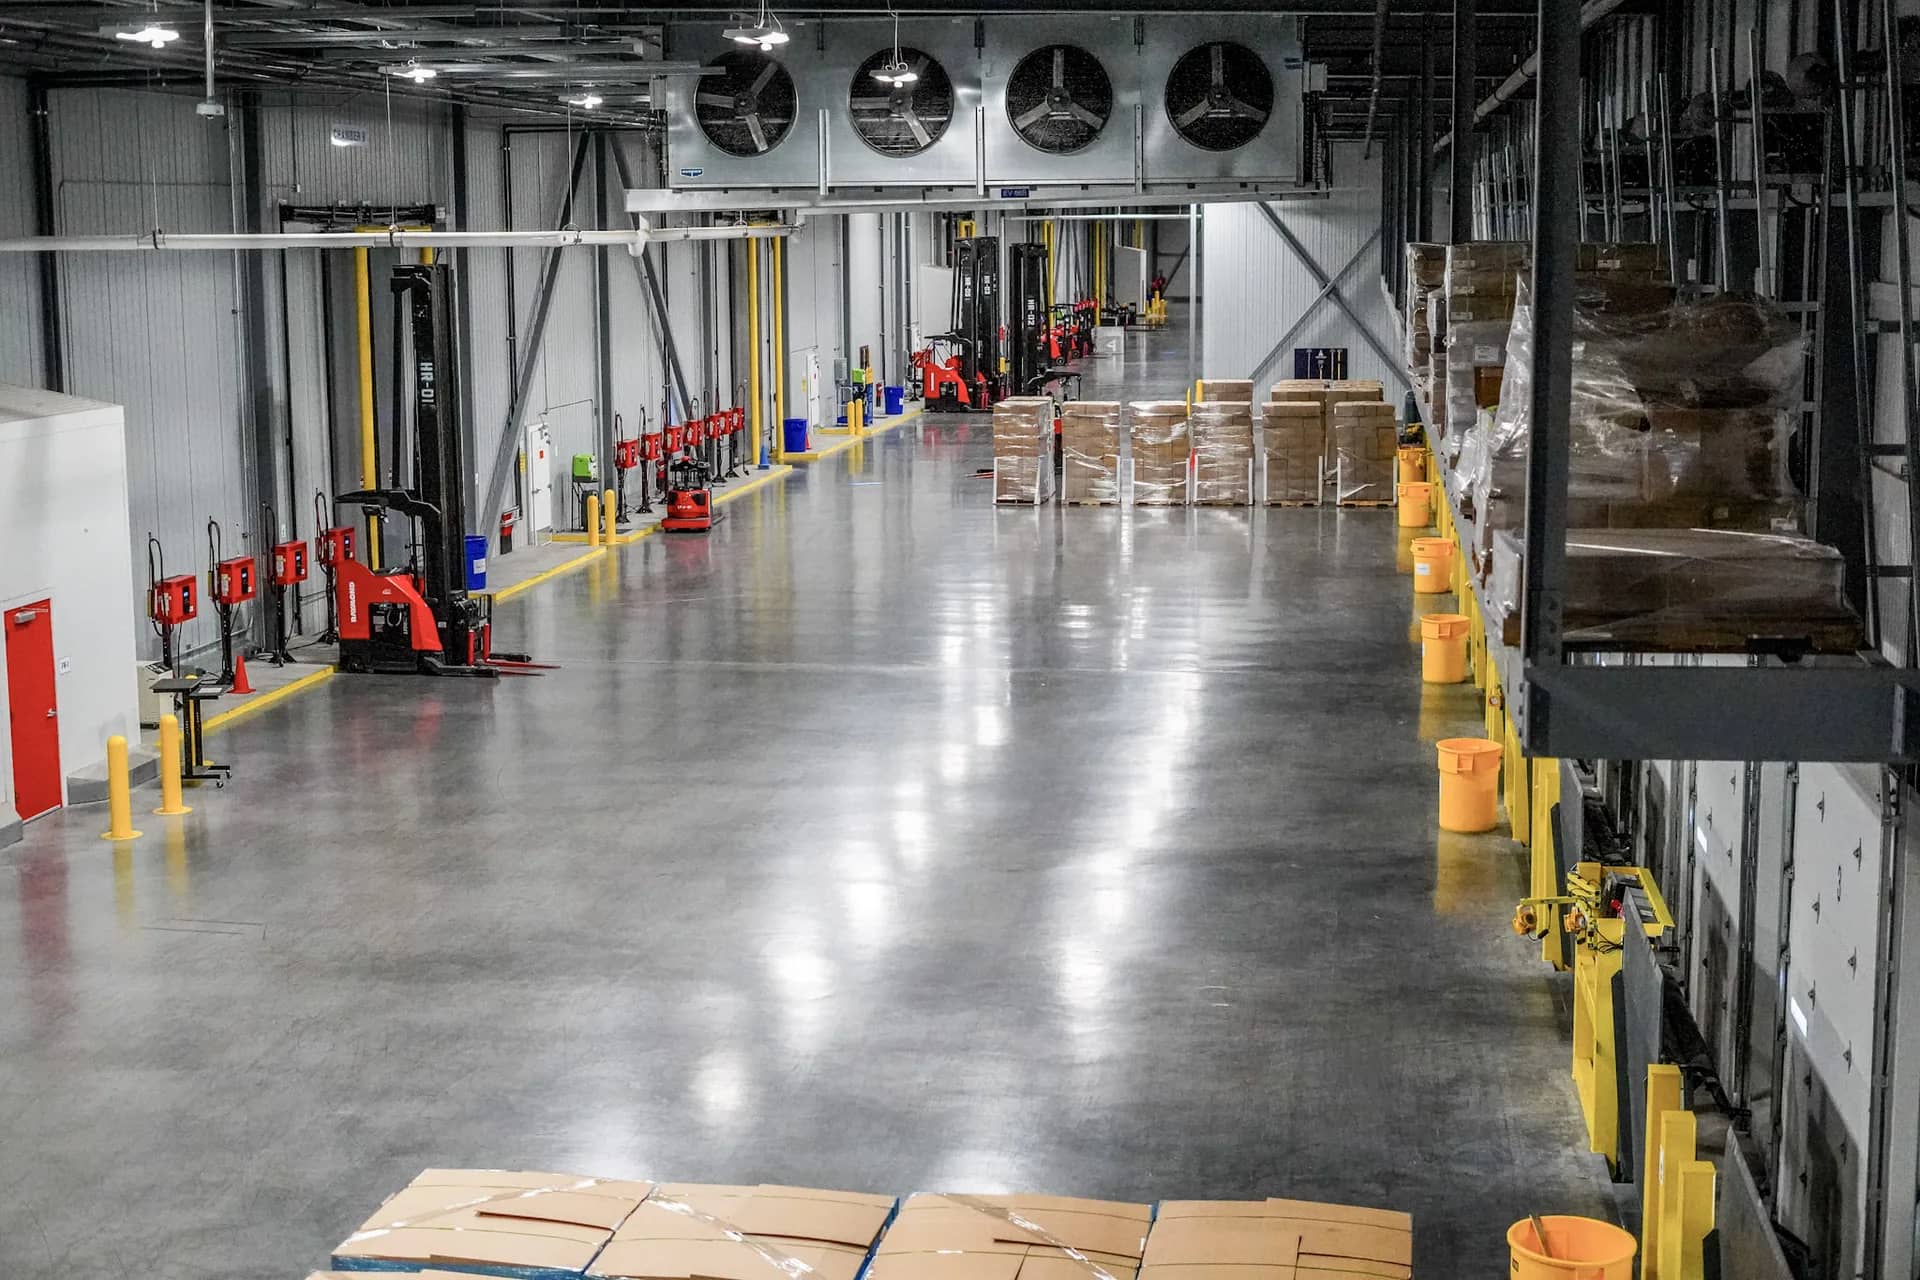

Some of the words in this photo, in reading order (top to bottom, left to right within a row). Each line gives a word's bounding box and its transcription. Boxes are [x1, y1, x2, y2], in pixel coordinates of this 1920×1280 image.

[1027, 299, 1035, 326] HR-02
[420, 362, 434, 403] HR-01
[349, 581, 357, 623] RAYMOND
